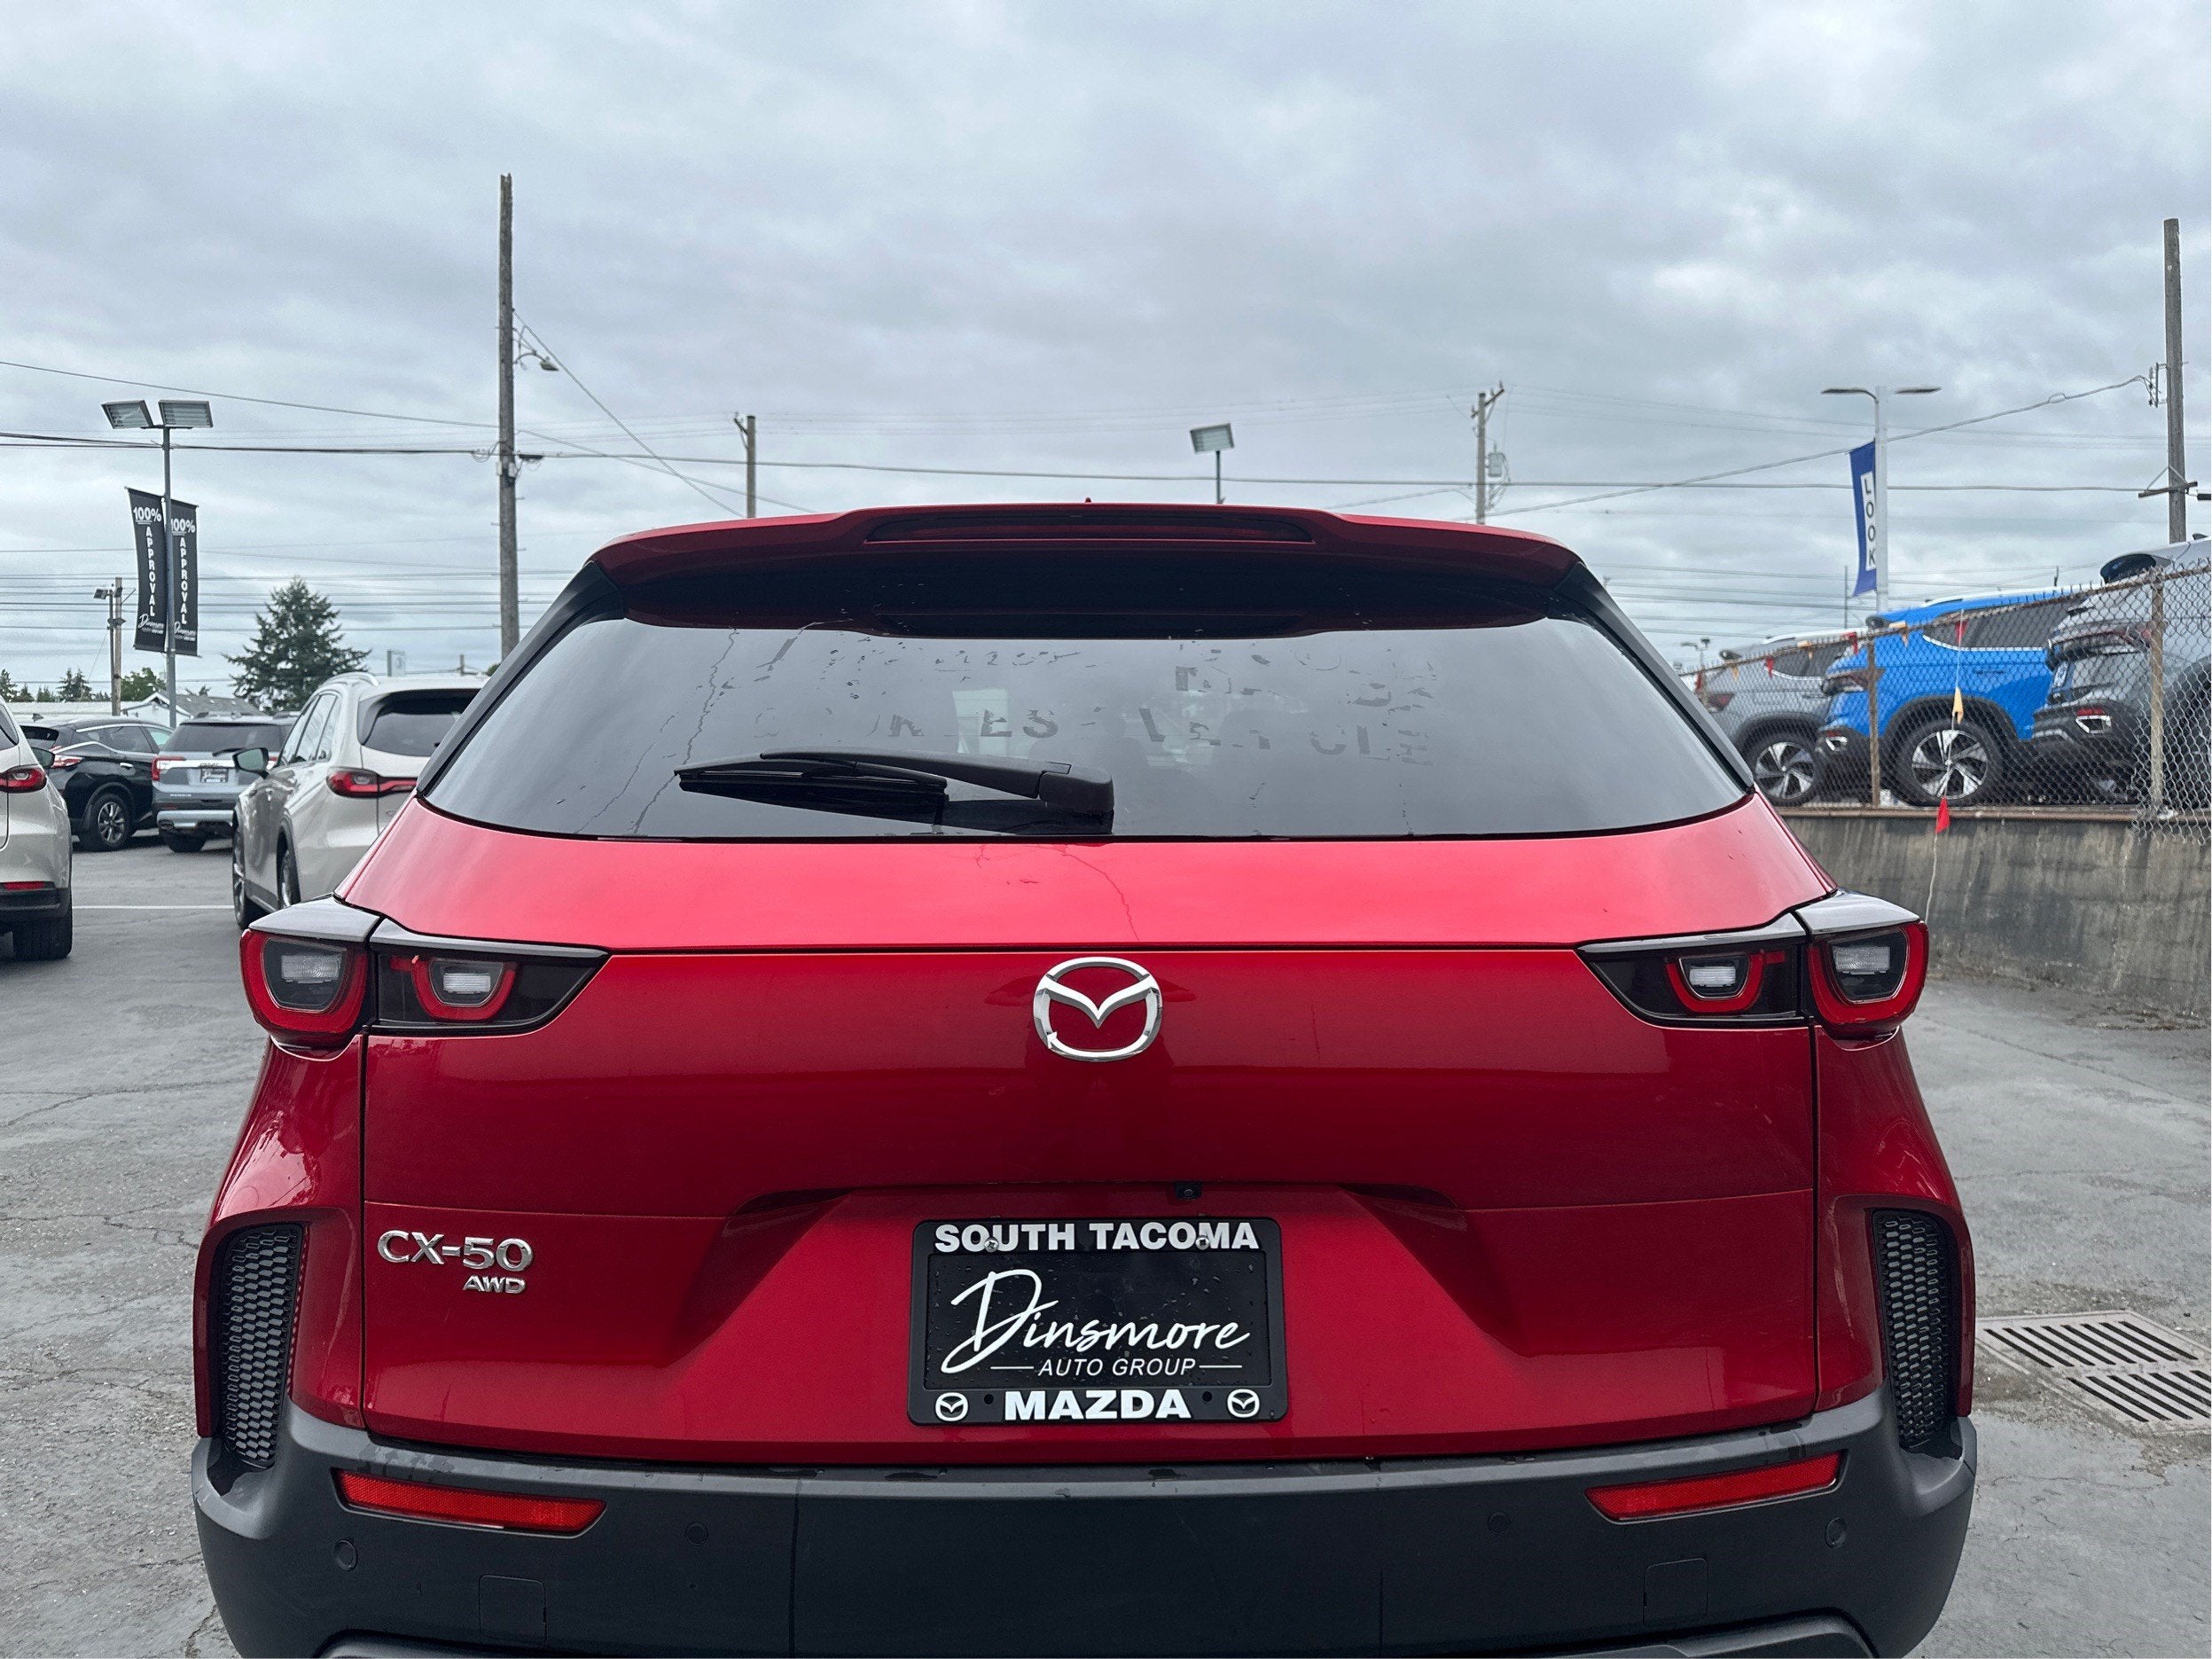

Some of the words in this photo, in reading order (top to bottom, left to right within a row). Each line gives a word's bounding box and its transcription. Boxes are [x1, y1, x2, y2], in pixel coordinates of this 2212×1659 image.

[133, 506, 162, 522] 100%
[171, 518, 196, 534] 100%
[1864, 479, 1876, 567] LOOK
[145, 526, 156, 616] APPROVAL
[179, 536, 188, 624] APPROVAL
[377, 1230, 535, 1272] CX-50
[934, 1224, 1075, 1252] SOUTH
[1089, 1222, 1259, 1250] TACOMA
[463, 1274, 527, 1295] AWD
[941, 1269, 1251, 1374] Dinsmore
[1037, 1358, 1104, 1377] AUTO
[1112, 1358, 1197, 1377] GROUP
[1004, 1389, 1192, 1420] MAZDA
